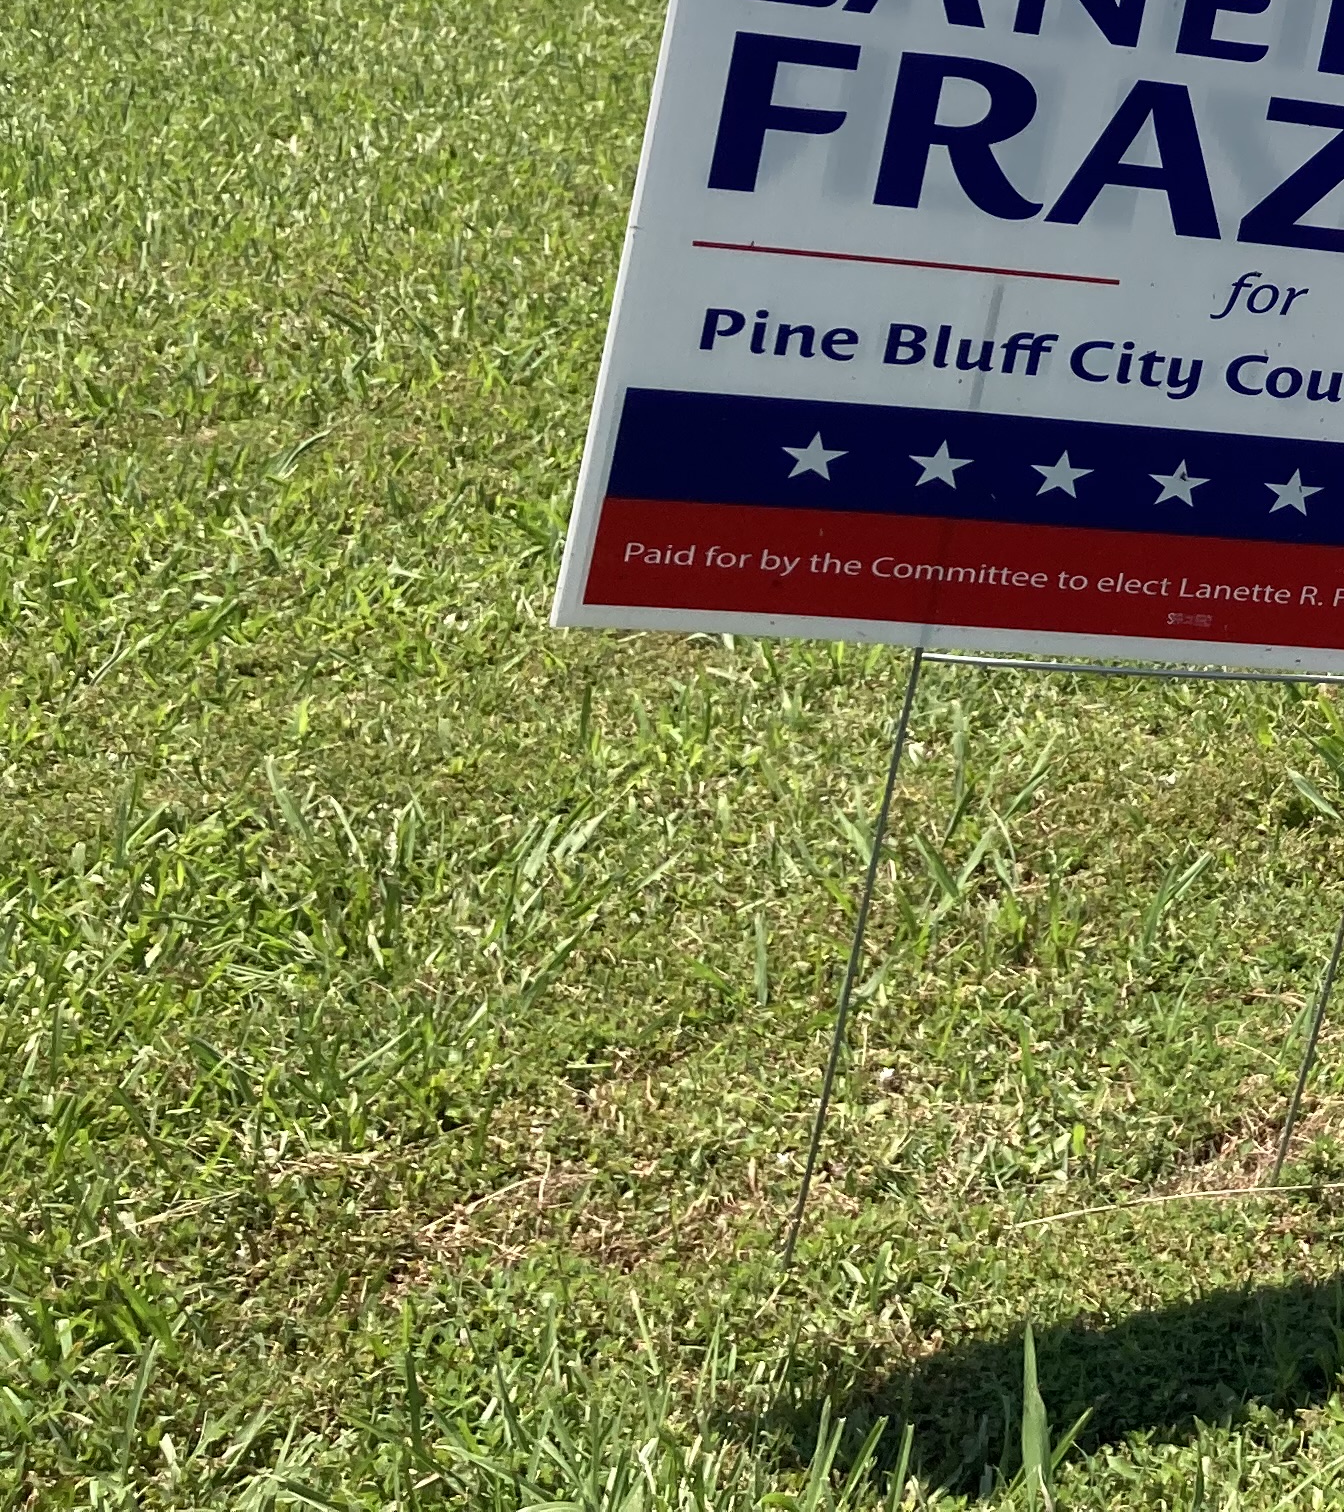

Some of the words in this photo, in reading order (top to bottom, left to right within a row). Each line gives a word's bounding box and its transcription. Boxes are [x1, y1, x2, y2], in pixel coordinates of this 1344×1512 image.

[1209, 271, 1310, 320] for
[699, 307, 859, 362] Pine
[882, 322, 1060, 376] Bluff
[1069, 340, 1204, 400] City
[623, 542, 696, 566] Paid
[704, 545, 753, 569] for
[760, 548, 801, 577] by
[809, 552, 862, 576] the
[871, 556, 1049, 589] Committee
[1057, 570, 1089, 591] to
[1096, 572, 1172, 596] elect
[1179, 577, 1291, 605] Lanette
[1299, 585, 1324, 607] R.
